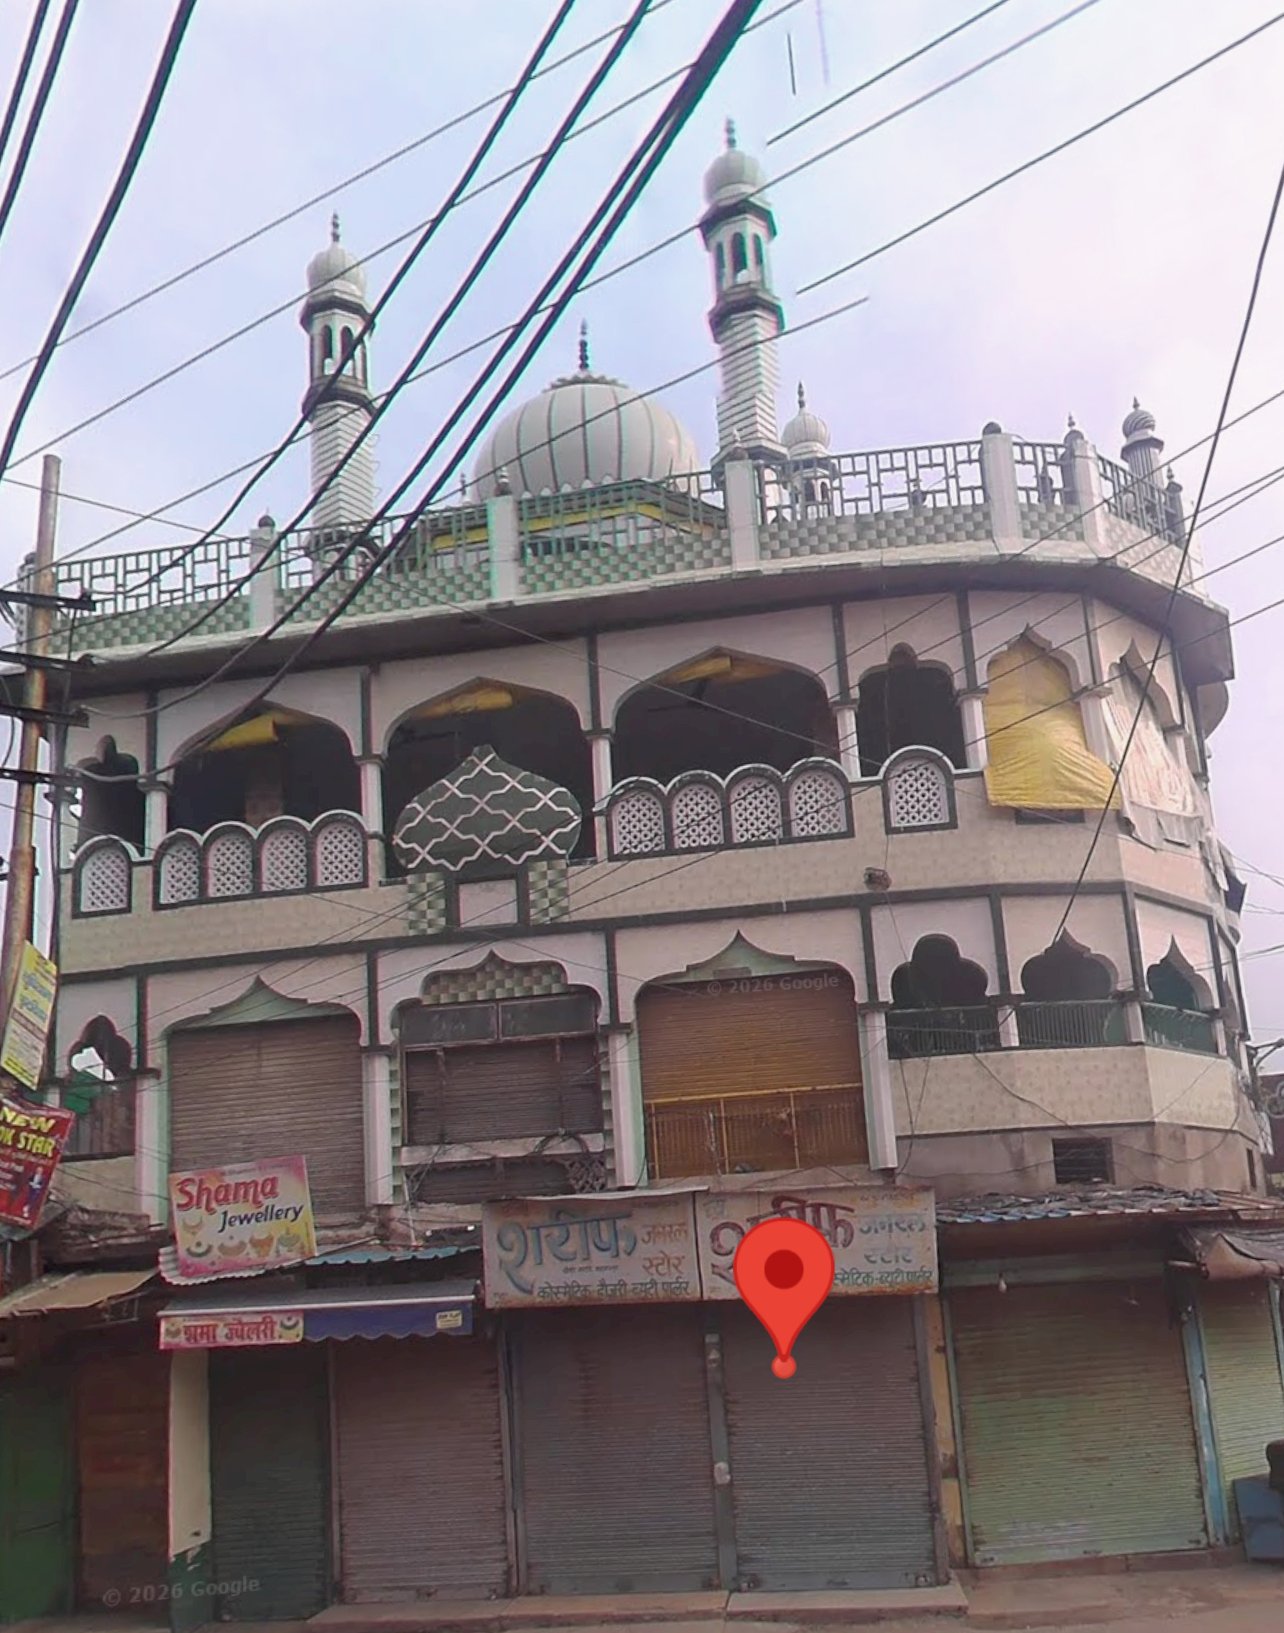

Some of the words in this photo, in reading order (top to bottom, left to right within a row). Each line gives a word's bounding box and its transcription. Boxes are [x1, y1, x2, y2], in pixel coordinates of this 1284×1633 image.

[1, 1106, 56, 1133] NEW
[17, 1131, 56, 1158] STAR
[176, 1176, 279, 1216] Shama
[218, 1204, 304, 1234] Jewellery
[497, 1210, 638, 1295] शरीफ
[641, 1250, 686, 1276] स्टोर
